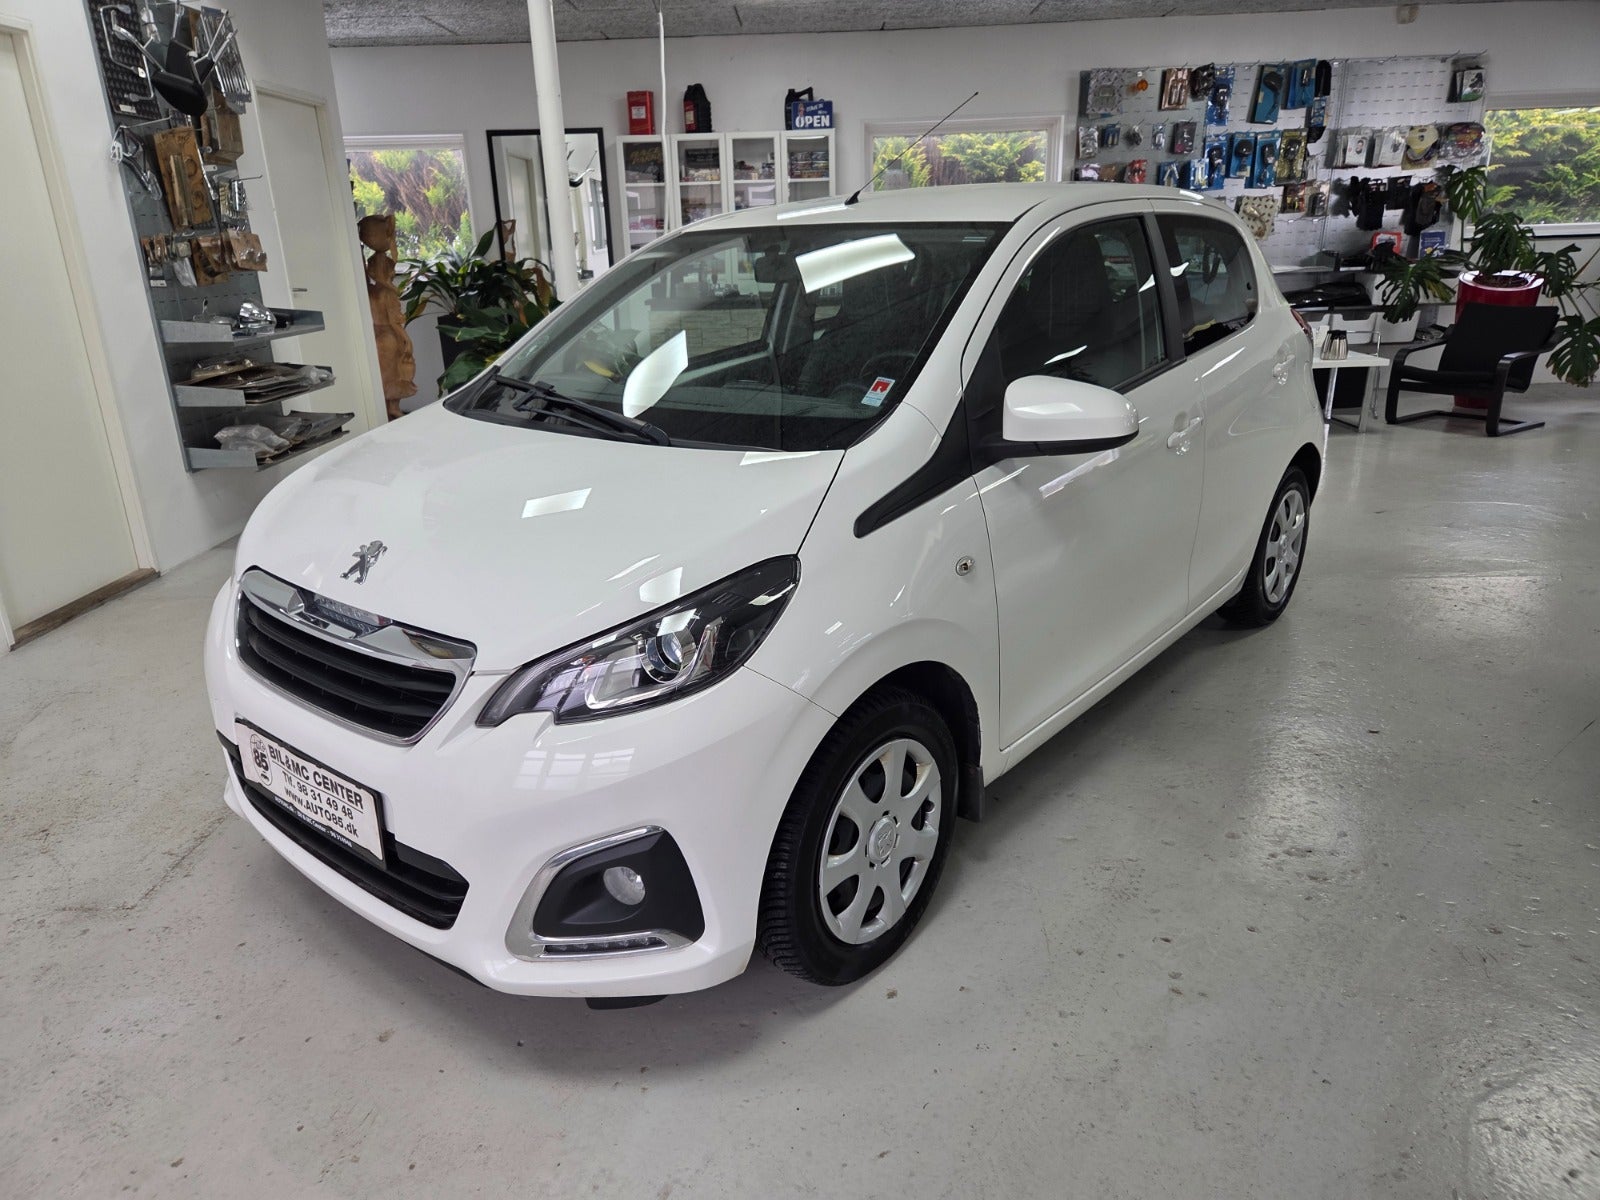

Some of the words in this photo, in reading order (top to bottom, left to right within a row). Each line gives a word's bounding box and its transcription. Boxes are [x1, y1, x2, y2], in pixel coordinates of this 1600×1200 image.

[795, 115, 830, 127] OPEN
[253, 748, 269, 771] 85
[268, 744, 309, 780] BIL&MC
[313, 771, 363, 809] CENTER
[297, 781, 308, 796] 98
[311, 789, 322, 803] 31
[326, 797, 338, 811] 49
[341, 805, 353, 820] 48
